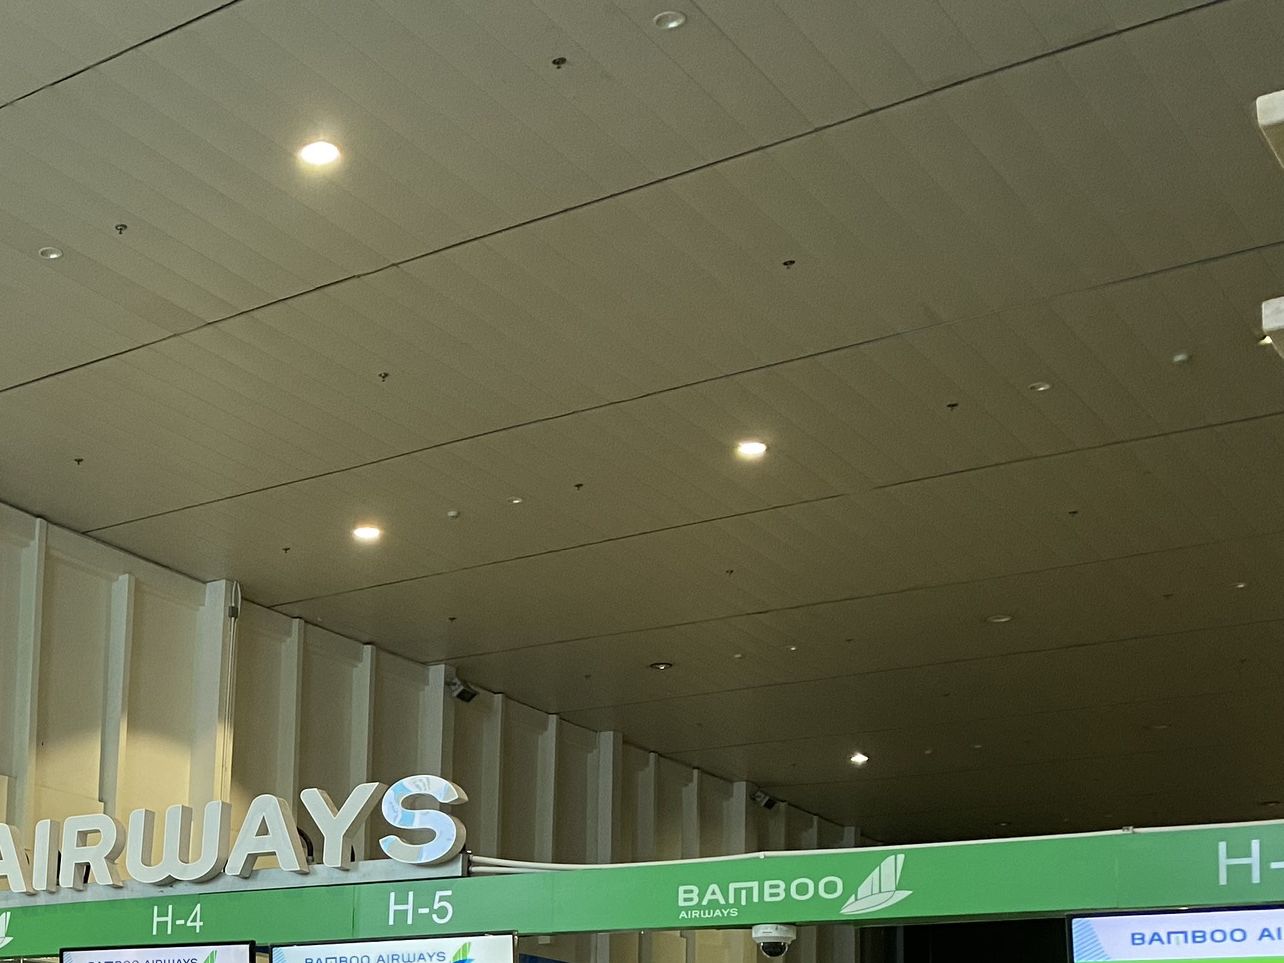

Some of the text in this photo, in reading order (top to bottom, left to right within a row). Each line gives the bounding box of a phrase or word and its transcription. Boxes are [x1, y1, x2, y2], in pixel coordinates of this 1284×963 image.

[678, 875, 843, 907] BAMBOO
[152, 903, 204, 936] H-4
[387, 890, 453, 926] H-5
[679, 907, 739, 919] AIRWAYS
[1130, 927, 1247, 946] BAMBOO
